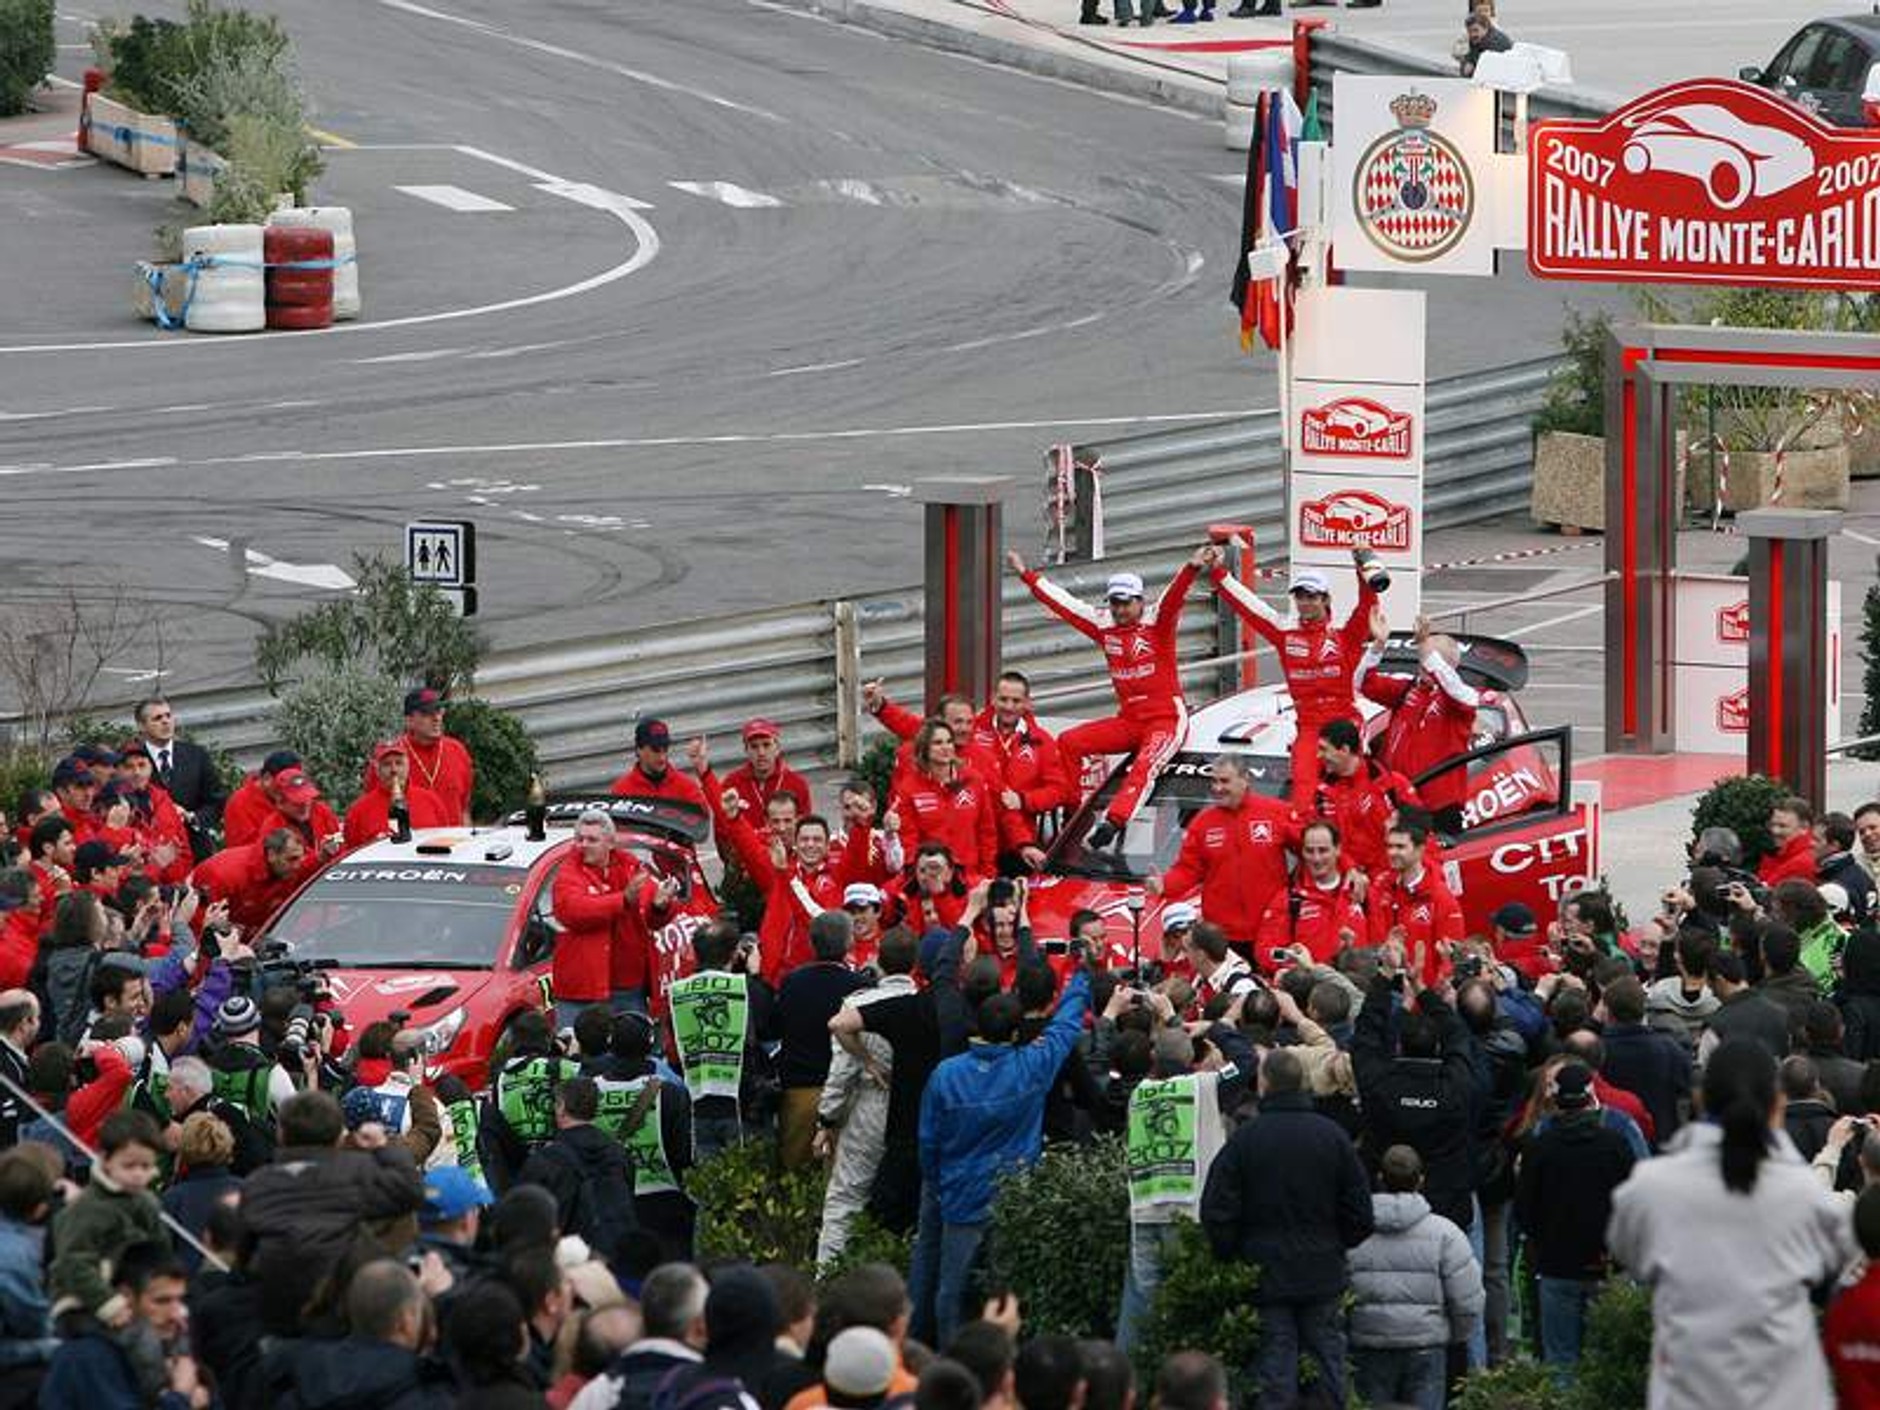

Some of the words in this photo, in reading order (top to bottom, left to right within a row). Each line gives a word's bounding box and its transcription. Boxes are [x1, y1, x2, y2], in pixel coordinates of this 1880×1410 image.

[1546, 138, 1616, 188] 2007
[1817, 153, 1880, 197] 2007
[1545, 172, 1649, 260] RALLYE
[1659, 187, 1880, 270] MONTE-CARLO
[509, 801, 654, 819] CTROËN
[1490, 829, 1587, 873] CIT
[325, 869, 466, 881] CITROËN
